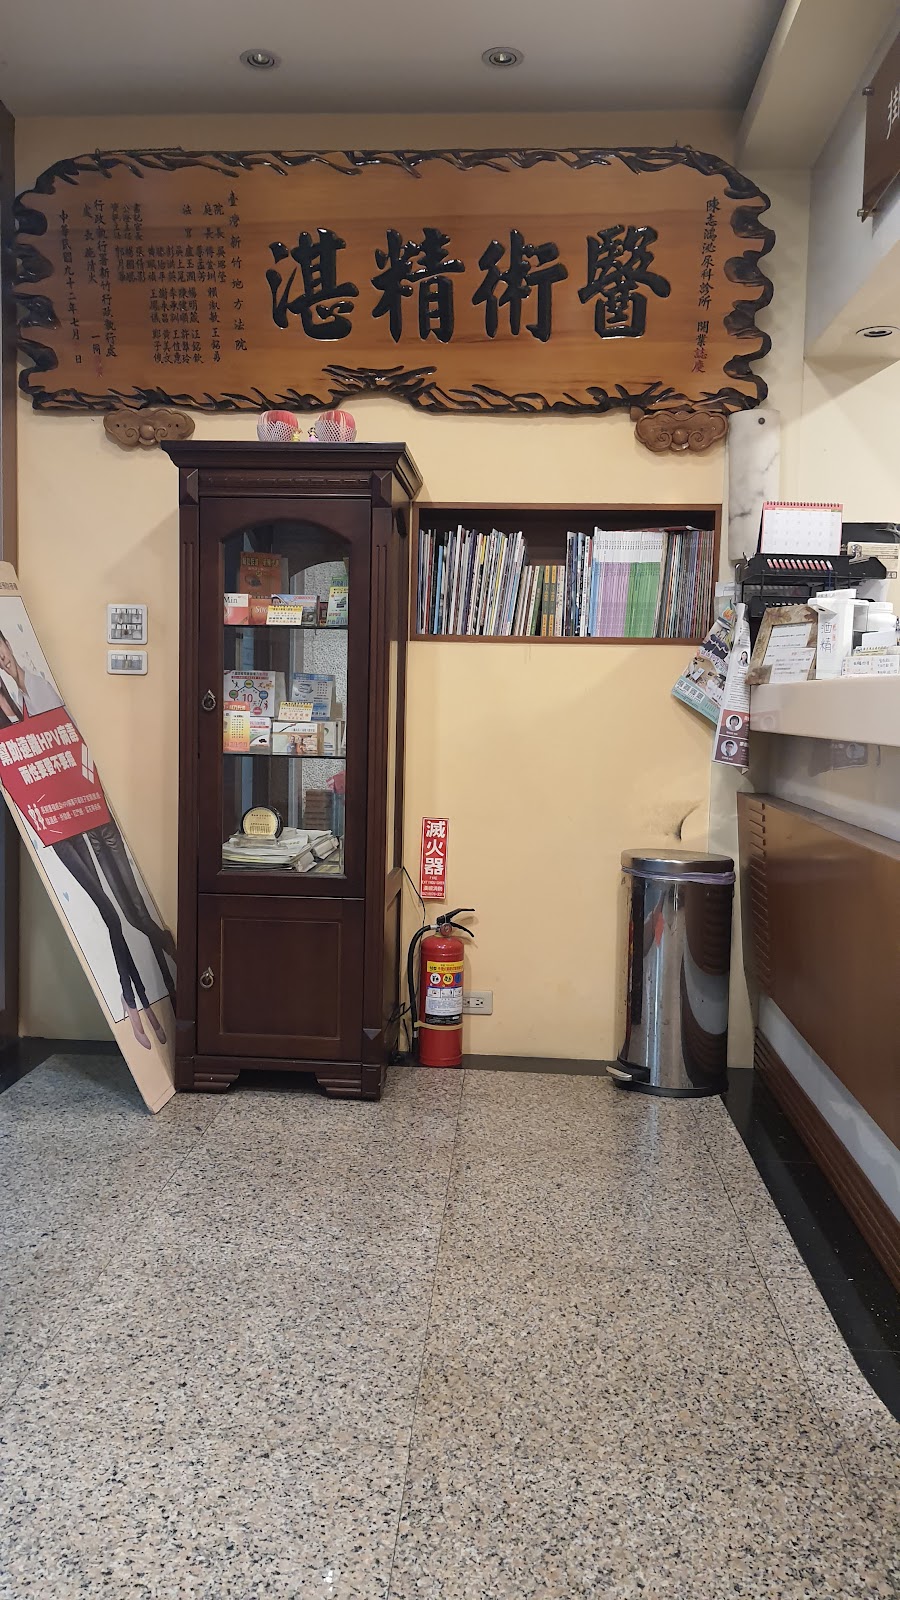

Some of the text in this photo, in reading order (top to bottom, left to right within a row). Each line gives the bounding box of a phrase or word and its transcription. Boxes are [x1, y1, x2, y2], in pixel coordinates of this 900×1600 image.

[203, 203, 214, 239] 庭長
[214, 203, 225, 238] 院長
[59, 209, 79, 340] 中華民國九十二年七月
[93, 199, 118, 357] 行政執行署新竹行政執行處
[228, 190, 247, 351] 臺灣新竹地方法院
[691, 320, 710, 373] 開業誌慶
[242, 693, 253, 703] 10
[424, 820, 446, 876] 滅火器
